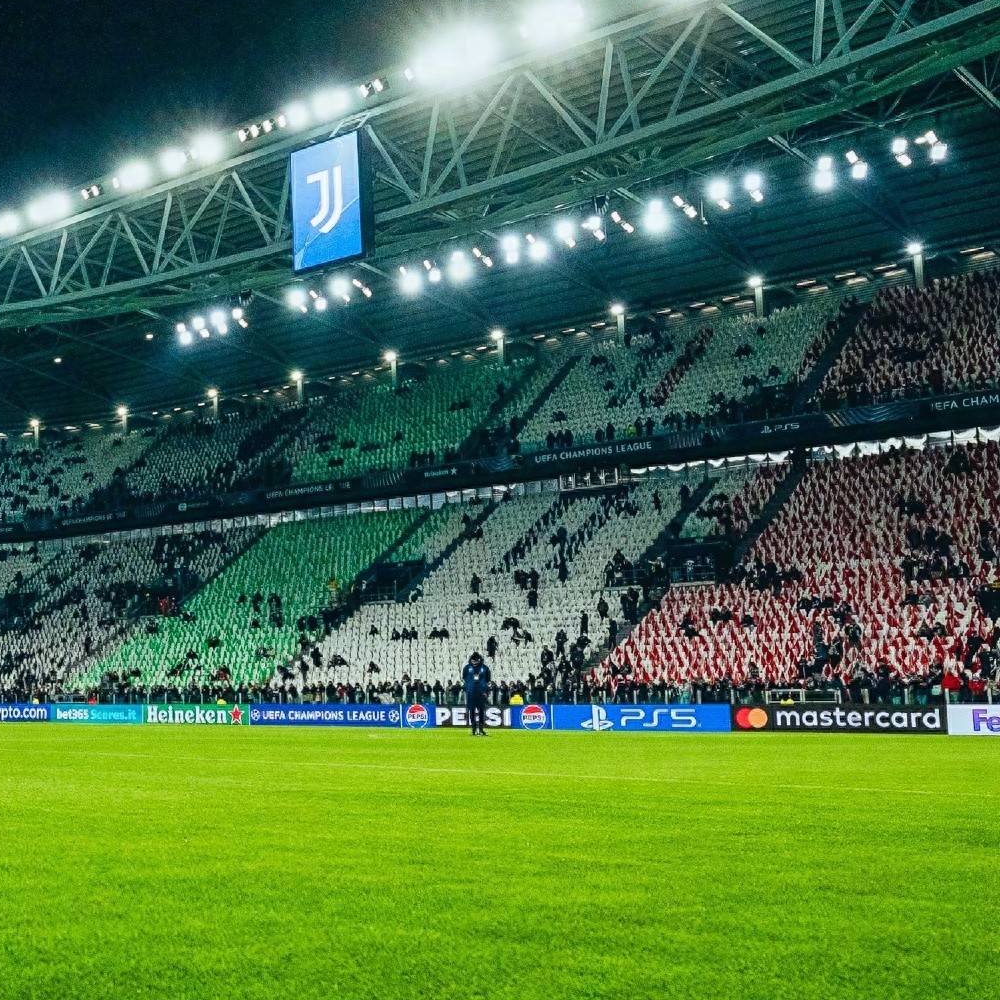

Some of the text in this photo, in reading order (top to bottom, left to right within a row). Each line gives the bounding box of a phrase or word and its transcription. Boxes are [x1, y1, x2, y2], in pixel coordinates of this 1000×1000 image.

[930, 399, 957, 411] EFA
[774, 422, 800, 431] PS5
[535, 441, 653, 463] UEFA CHAMPIONS LEAGUE
[56, 708, 137, 720] bet365 Scores.it
[147, 705, 227, 724] Heineken
[262, 710, 386, 721] UEFA CHAMPIONS LEAGUE
[435, 707, 512, 726] PESI
[620, 708, 697, 727] PS5
[776, 707, 941, 728] mastercard
